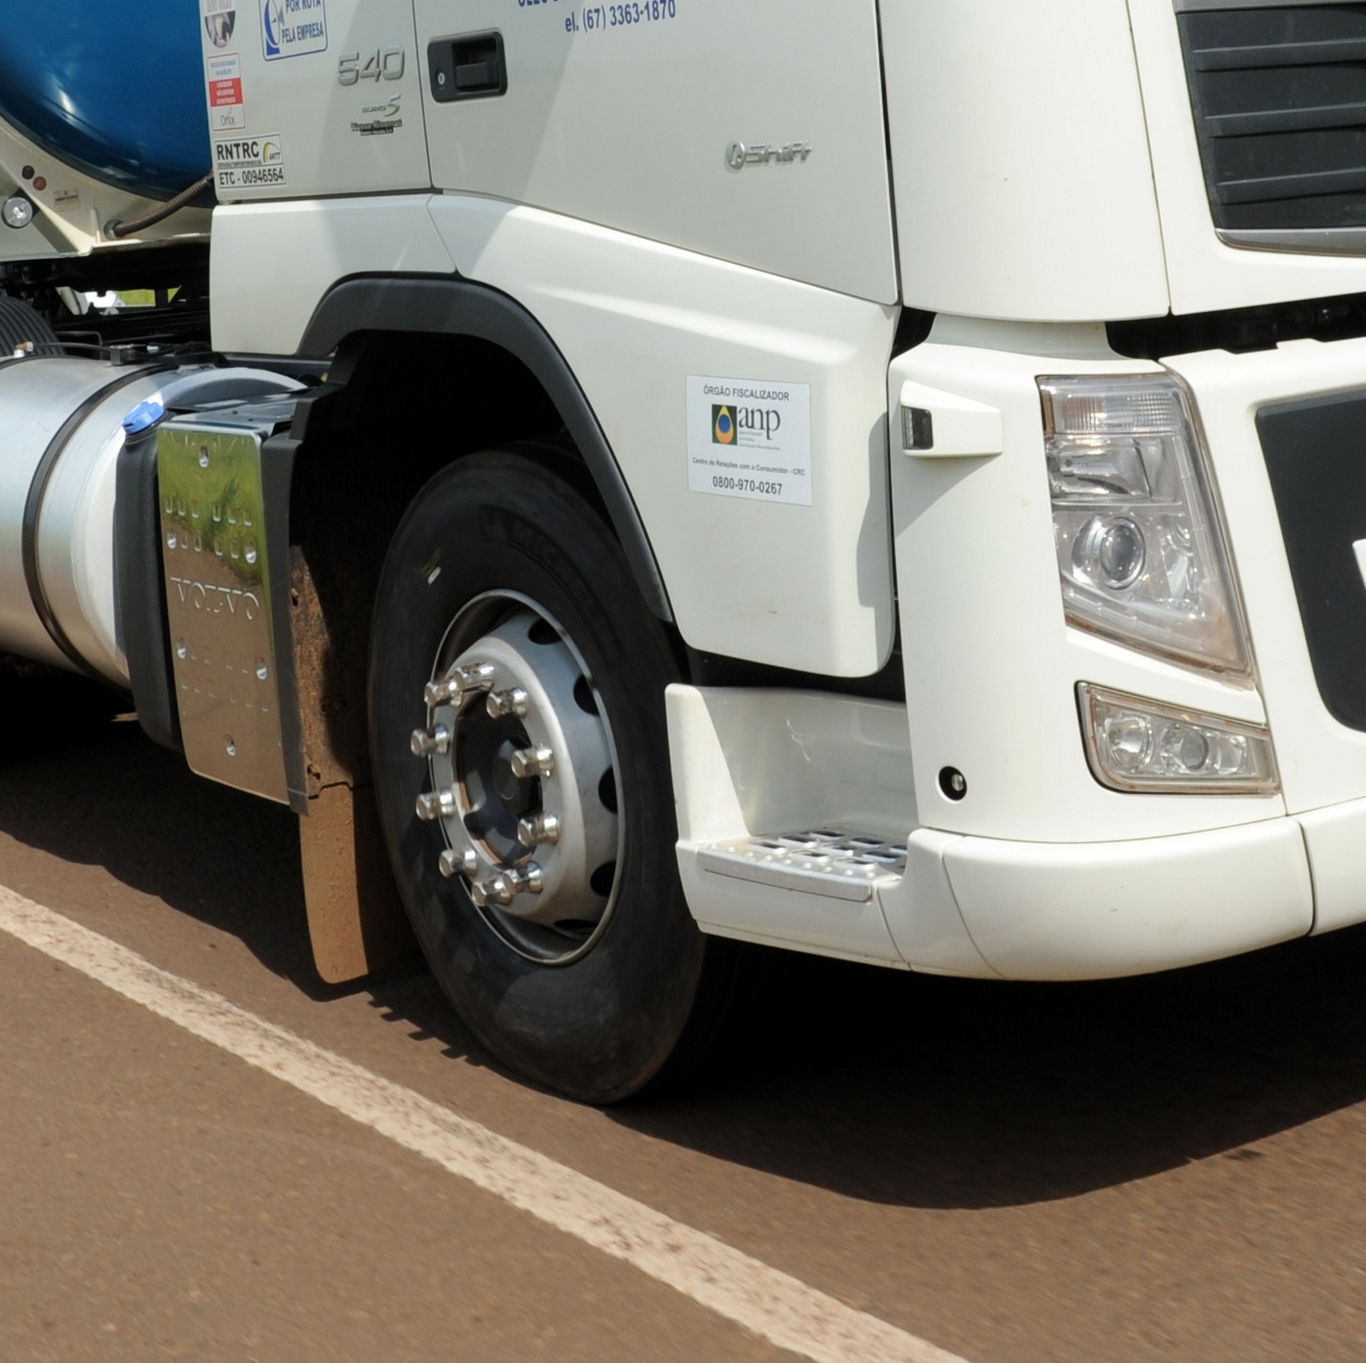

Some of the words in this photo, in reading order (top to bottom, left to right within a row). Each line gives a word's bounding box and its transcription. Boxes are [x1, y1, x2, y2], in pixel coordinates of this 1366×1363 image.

[582, 4, 607, 34] (67)
[281, 28, 297, 44] PELA
[297, 21, 325, 41] EMPRESA
[338, 45, 406, 87] 540
[216, 141, 260, 161] RNTRC
[218, 171, 236, 186] ETC
[703, 383, 731, 398] ÓRGÃO
[732, 388, 790, 402] FISCALIZADOR
[738, 406, 782, 441] anp
[712, 475, 783, 496] 0800-970-0267
